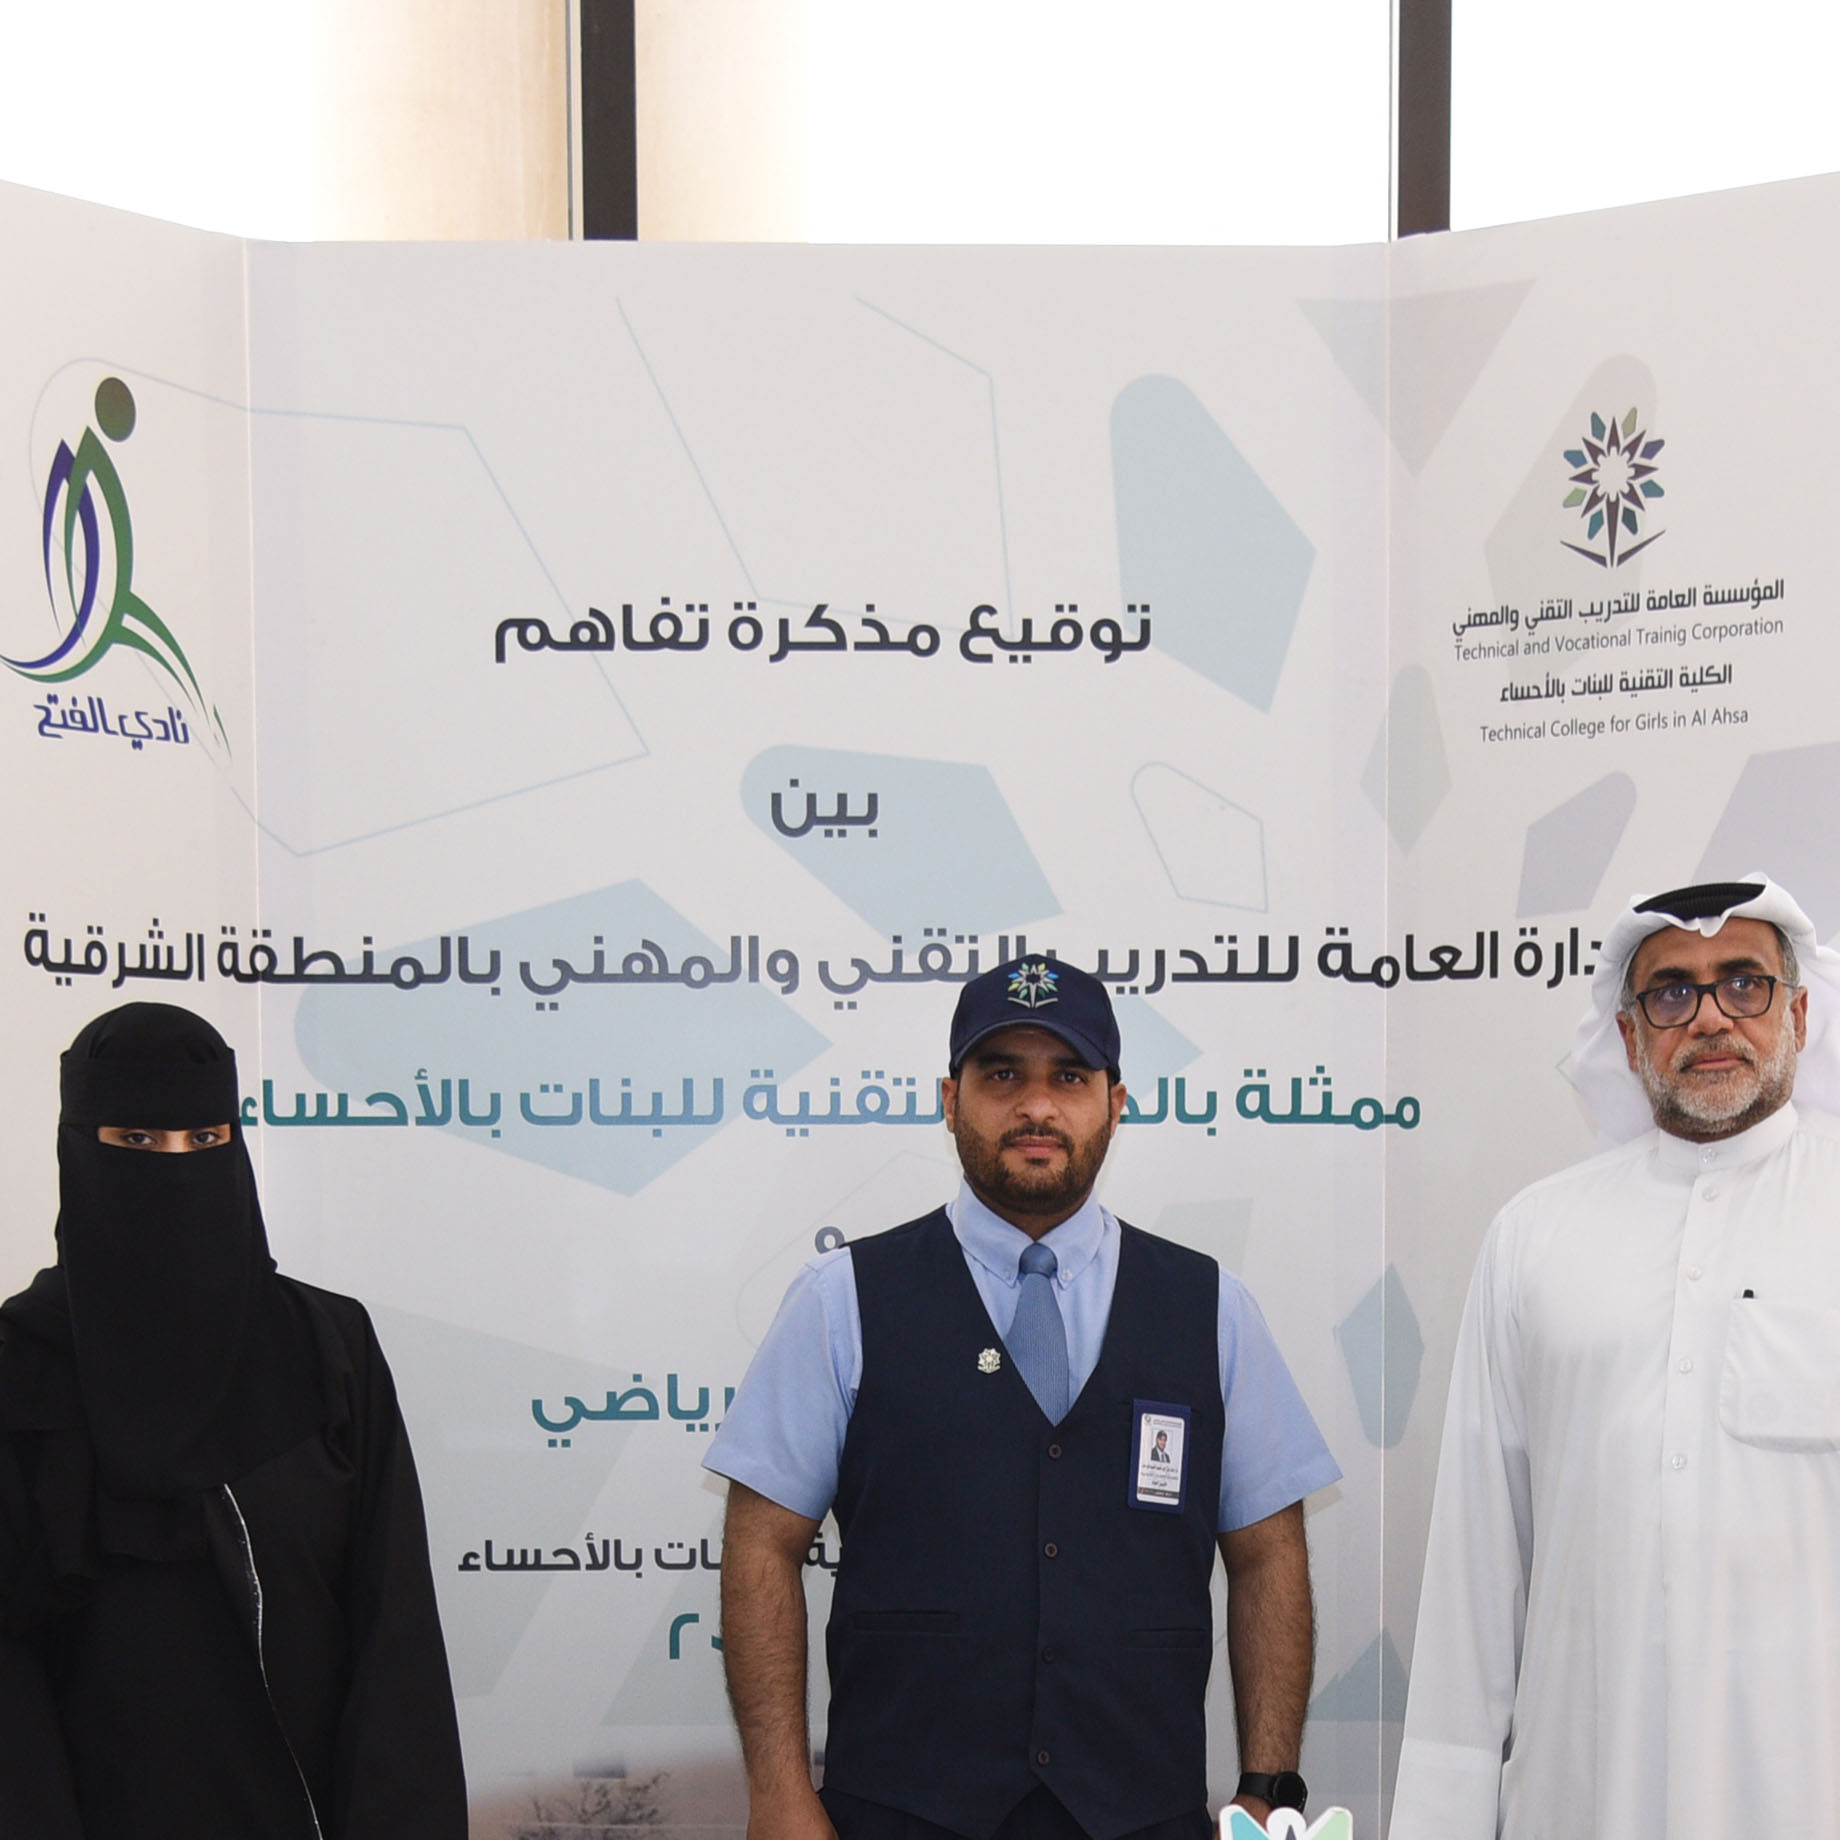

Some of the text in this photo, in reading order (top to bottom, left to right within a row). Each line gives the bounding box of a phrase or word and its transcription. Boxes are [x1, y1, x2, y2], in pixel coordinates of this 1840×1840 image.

[494, 597, 1152, 664] توقيع مذكرة تفاهم
[1452, 578, 1785, 643] المؤسسة العامة للتدريب التقني والمهني
[1454, 617, 1785, 662] Technical and Vocational Trainig Corporation
[1500, 664, 1733, 703] الكلية التقنية للبنات بالأحساء
[117, 706, 190, 750] نادي
[1480, 706, 1749, 743] Technical College for Girls in Al Ahsa
[770, 778, 879, 838] بين
[23, 912, 205, 989] الشرقية
[217, 925, 501, 996] بالمنطقة
[519, 935, 800, 1011] والمهني
[1318, 926, 1499, 989] العامة
[240, 1067, 502, 1138] بالأحساء
[520, 1077, 725, 1138] للبنات
[742, 1069, 945, 1138] لتقنية
[1236, 1065, 1421, 1131] ممثلة
[458, 1532, 643, 1578] بالأحساء
